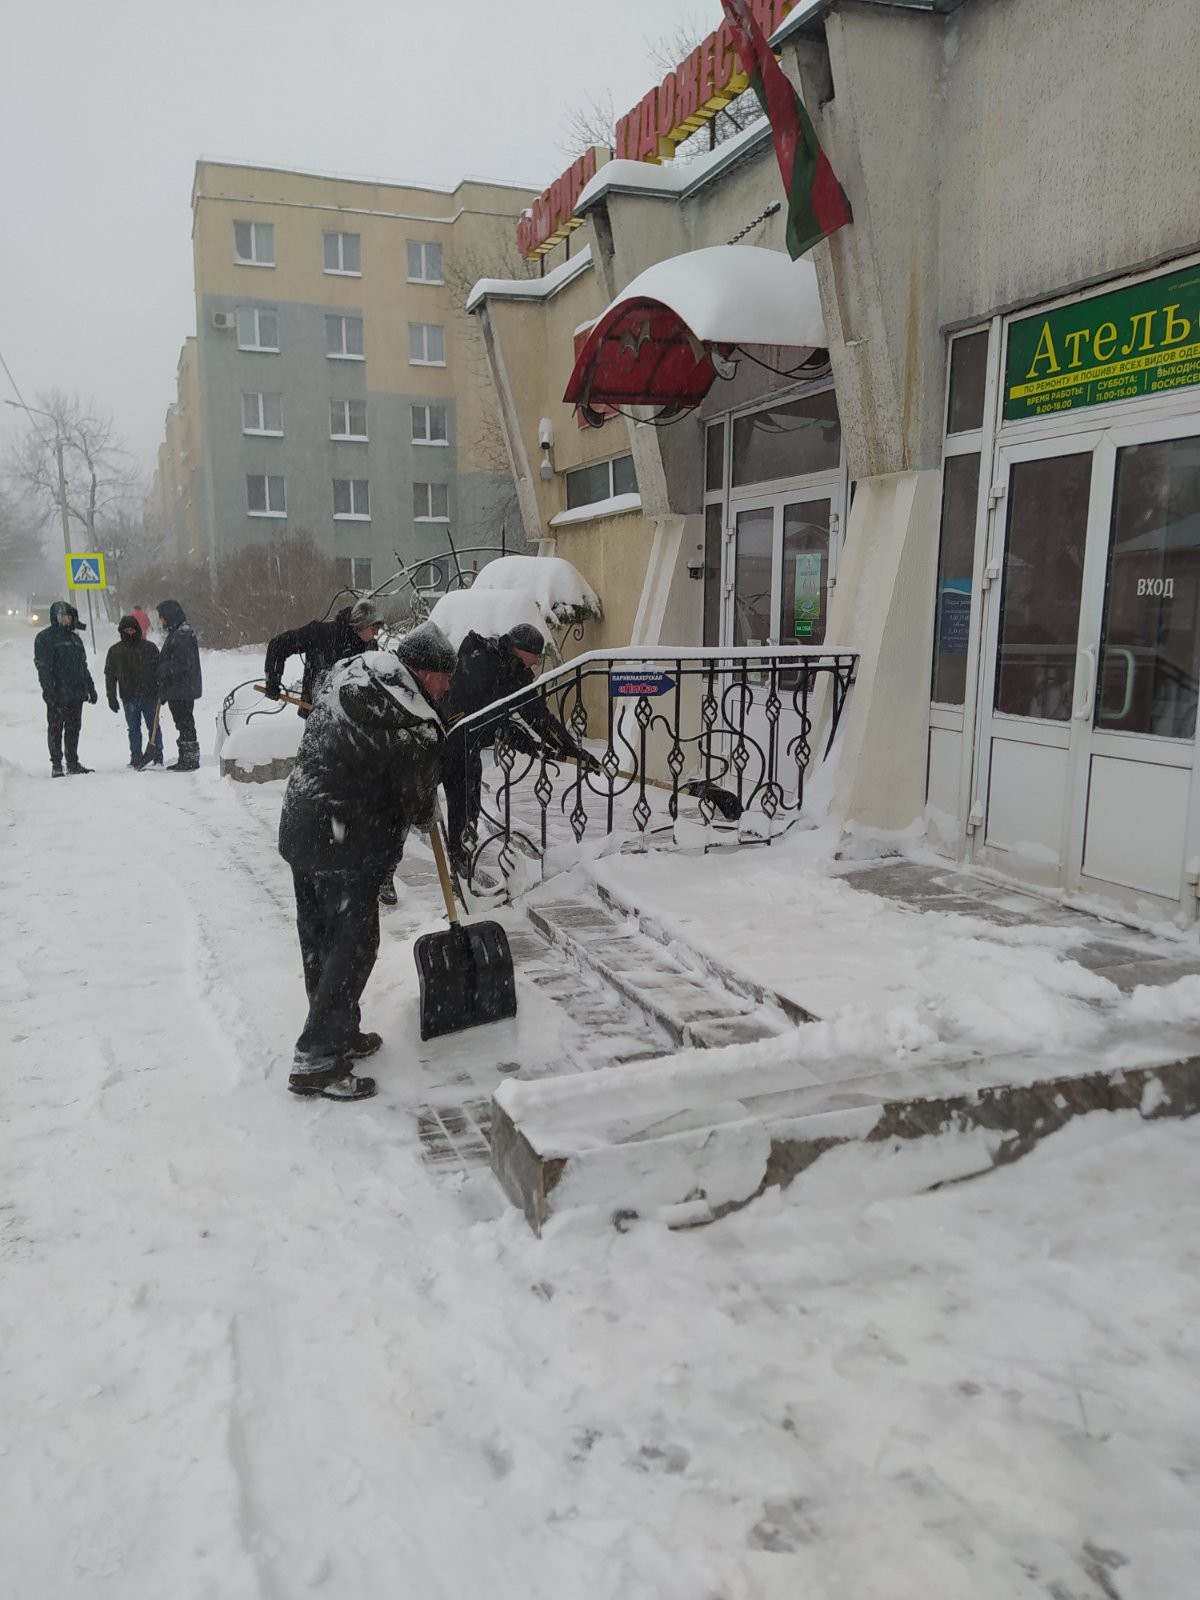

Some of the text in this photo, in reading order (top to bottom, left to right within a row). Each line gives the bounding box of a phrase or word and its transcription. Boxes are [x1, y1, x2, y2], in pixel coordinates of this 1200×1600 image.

[1025, 303, 1200, 379] Атель
[1023, 386, 1035, 394] ПО
[1036, 376, 1072, 391] РЕМОНТУ
[1080, 365, 1118, 380] ПОШИВУ
[1120, 360, 1142, 372] ВСЕХ
[1144, 352, 1176, 365] ВИДОВ
[1178, 346, 1200, 359] ОДЕ
[1097, 375, 1138, 390] СУББОТА:
[1026, 387, 1084, 406] ВРЕМЯ РАБОТЫ:
[1095, 386, 1138, 401] 11.00-15.00
[1136, 578, 1174, 599] ВХОД
